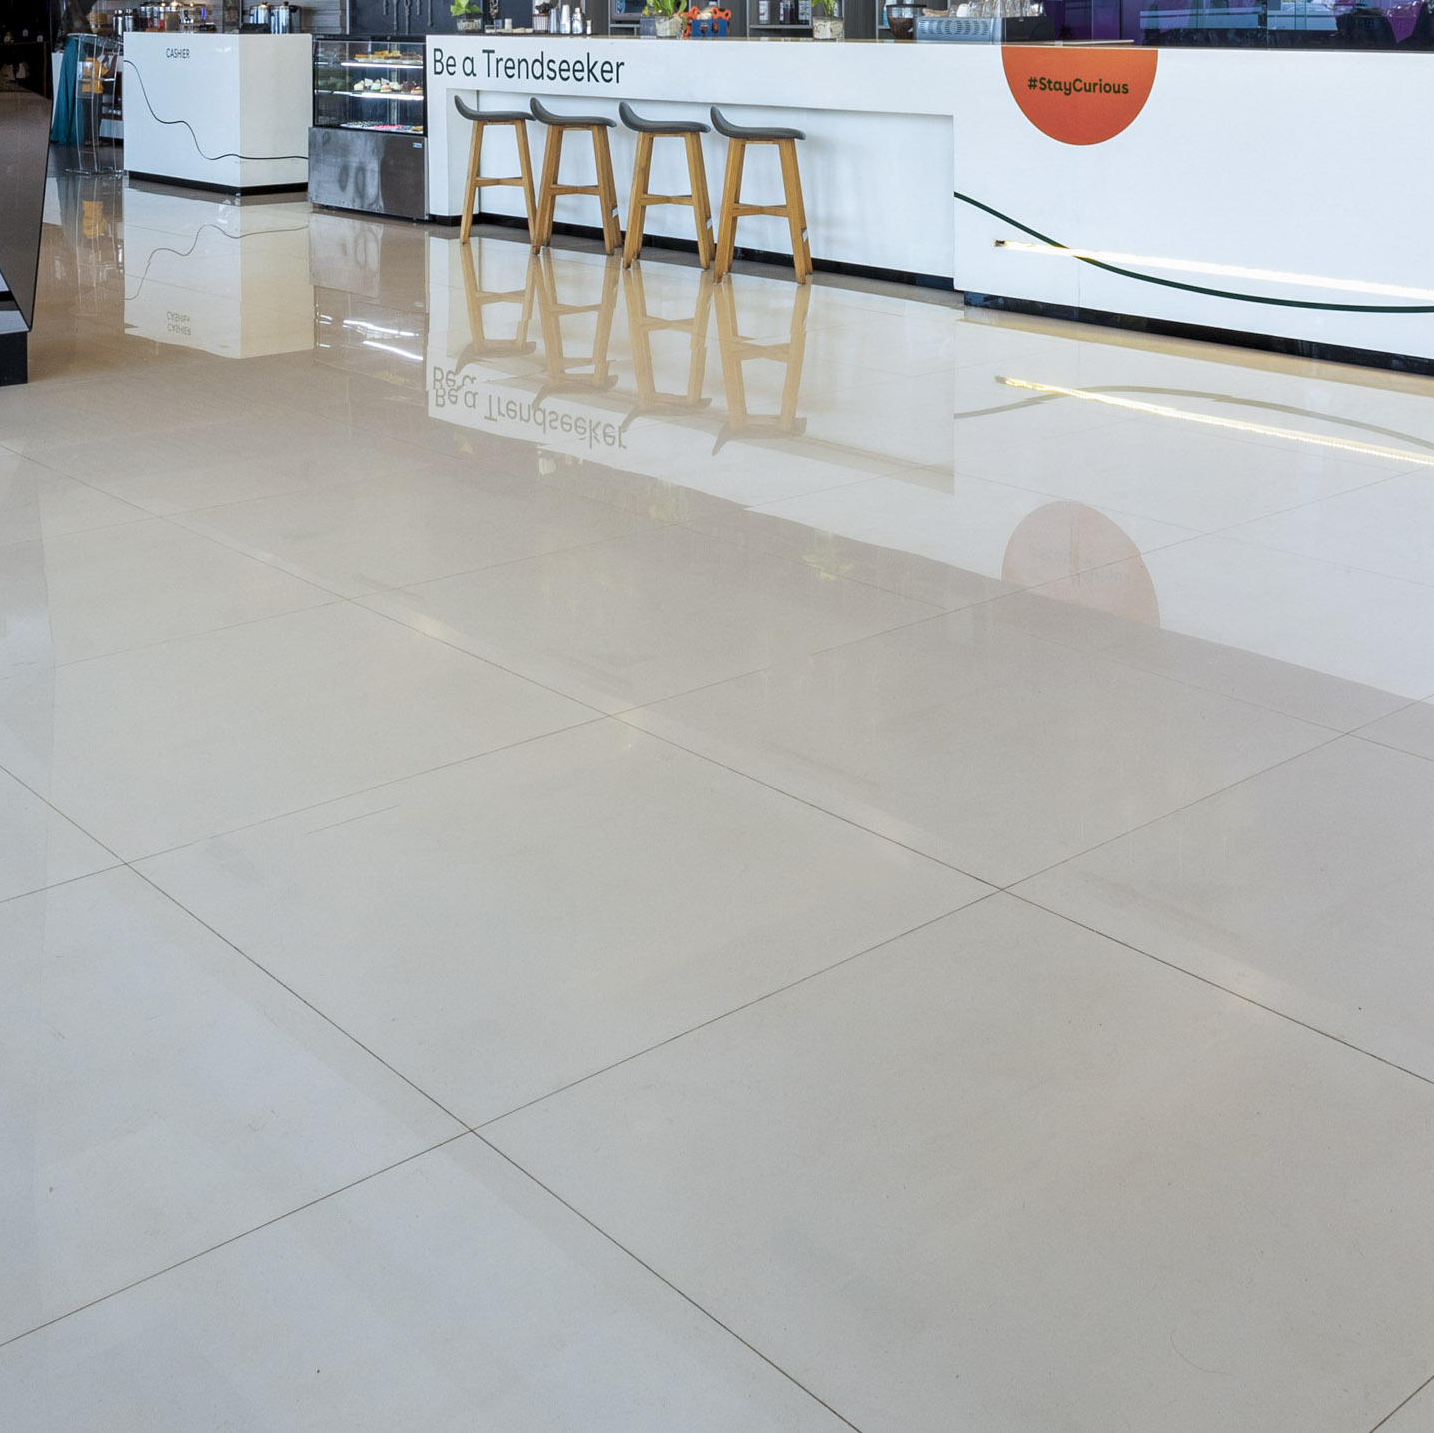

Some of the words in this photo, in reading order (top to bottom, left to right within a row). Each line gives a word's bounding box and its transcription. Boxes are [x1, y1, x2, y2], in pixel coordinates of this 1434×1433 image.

[166, 47, 191, 59] CASHIER
[433, 47, 456, 77] Be
[463, 54, 475, 77] a
[482, 49, 625, 86] Trendseeker
[1027, 76, 1130, 97] #StayCurious
